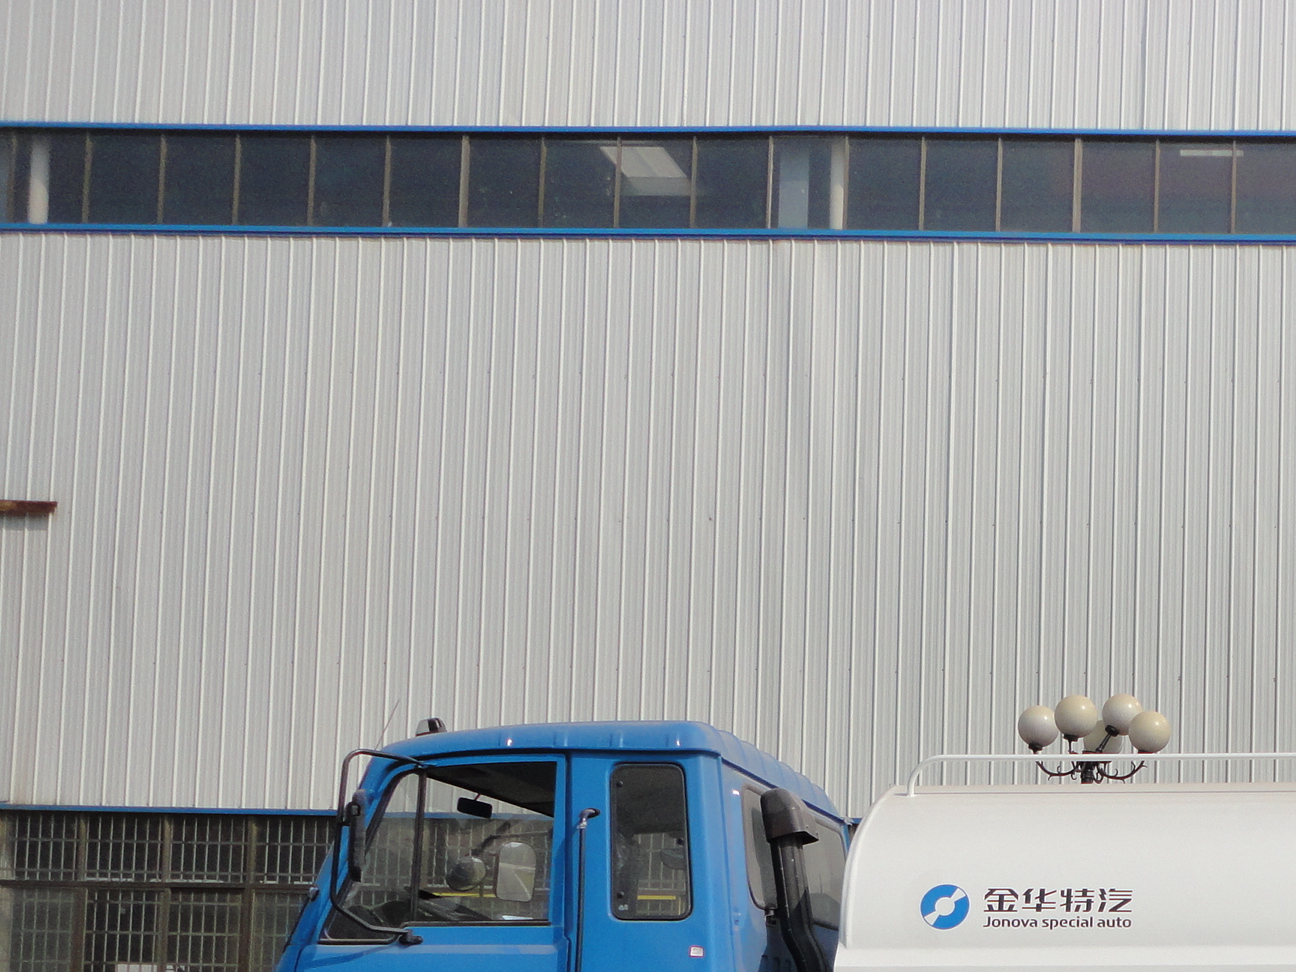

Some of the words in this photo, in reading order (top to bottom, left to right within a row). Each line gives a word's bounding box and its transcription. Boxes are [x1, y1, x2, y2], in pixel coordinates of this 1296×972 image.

[983, 888, 1133, 913] 金华特汽
[983, 916, 1038, 928] Jonova
[1042, 915, 1093, 930] special
[1097, 917, 1132, 928] auto
